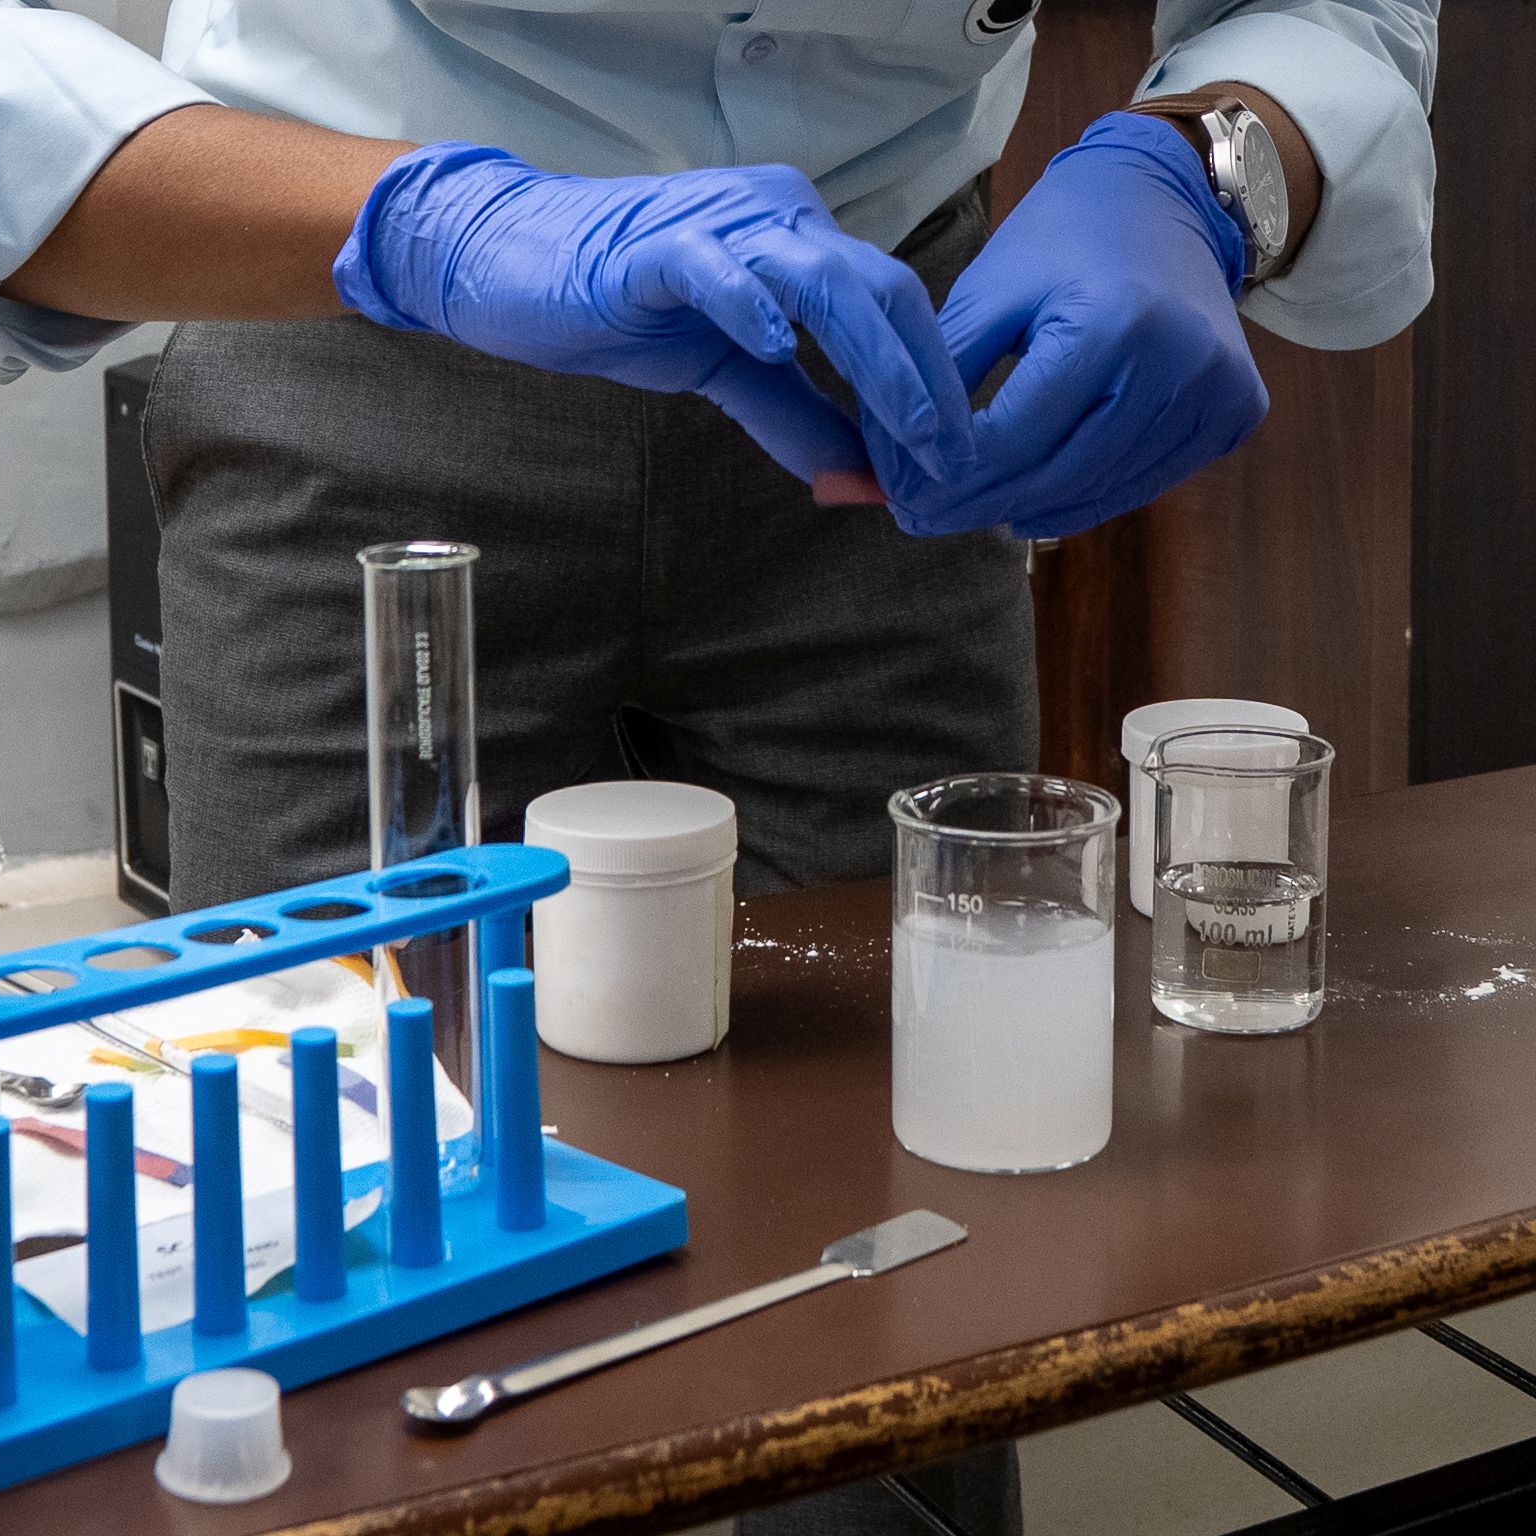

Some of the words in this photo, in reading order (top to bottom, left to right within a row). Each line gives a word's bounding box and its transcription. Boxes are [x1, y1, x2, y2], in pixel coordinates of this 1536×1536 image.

[947, 893, 984, 915] 150
[1213, 894, 1257, 917] GLASS
[1199, 920, 1237, 946] 100
[1244, 925, 1273, 948] ml
